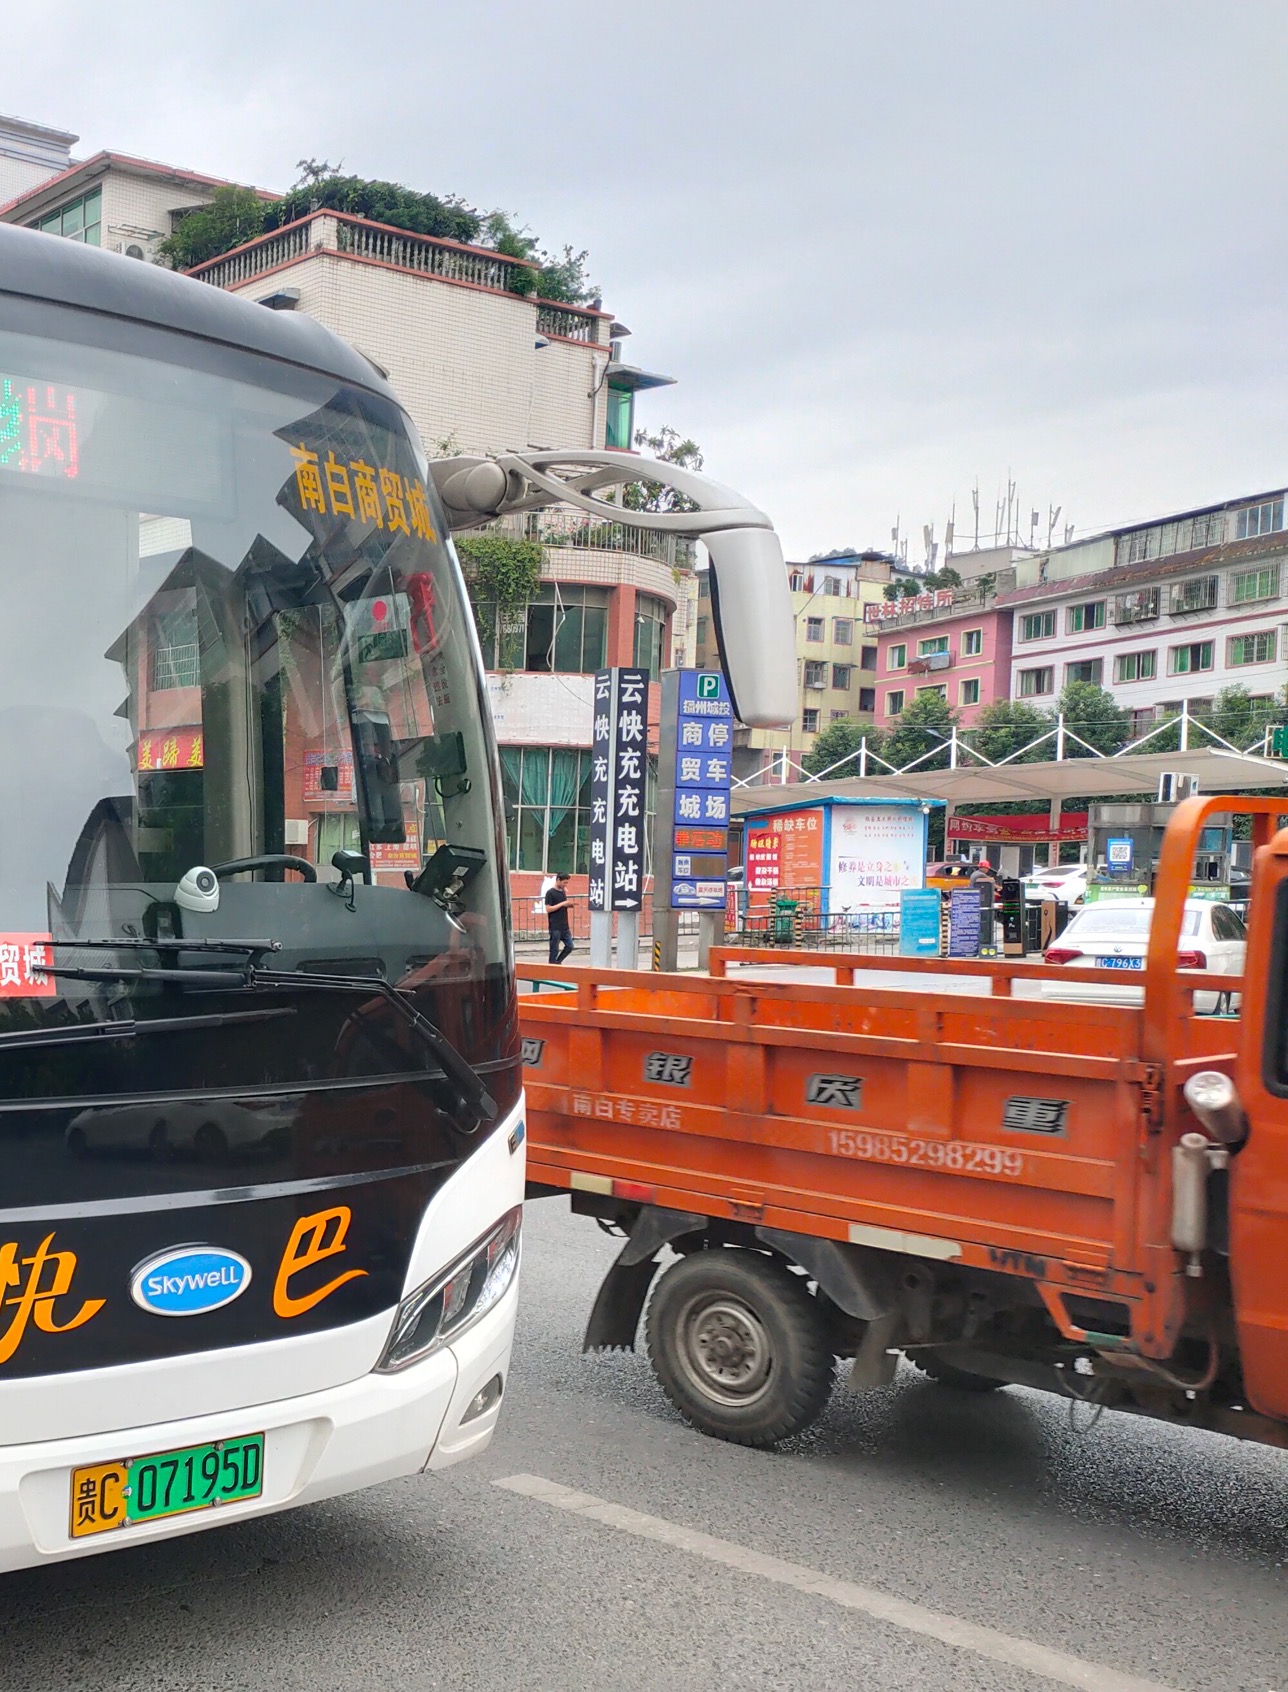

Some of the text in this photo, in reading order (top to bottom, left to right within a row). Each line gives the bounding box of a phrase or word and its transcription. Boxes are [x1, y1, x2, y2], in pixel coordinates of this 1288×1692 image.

[289, 441, 437, 544] 南白商贸城
[703, 677, 716, 697] P
[589, 674, 611, 904] 云快充充电站
[615, 673, 644, 892] 云快充充电站
[680, 722, 704, 819] 商贸城
[705, 722, 729, 819] 停车场
[573, 1093, 682, 1130] 南白专卖店
[645, 1051, 1070, 1137] 银 庆 重
[827, 1129, 1024, 1177] 15985298299
[147, 1266, 239, 1297] Skywell
[273, 1206, 369, 1318] 巴
